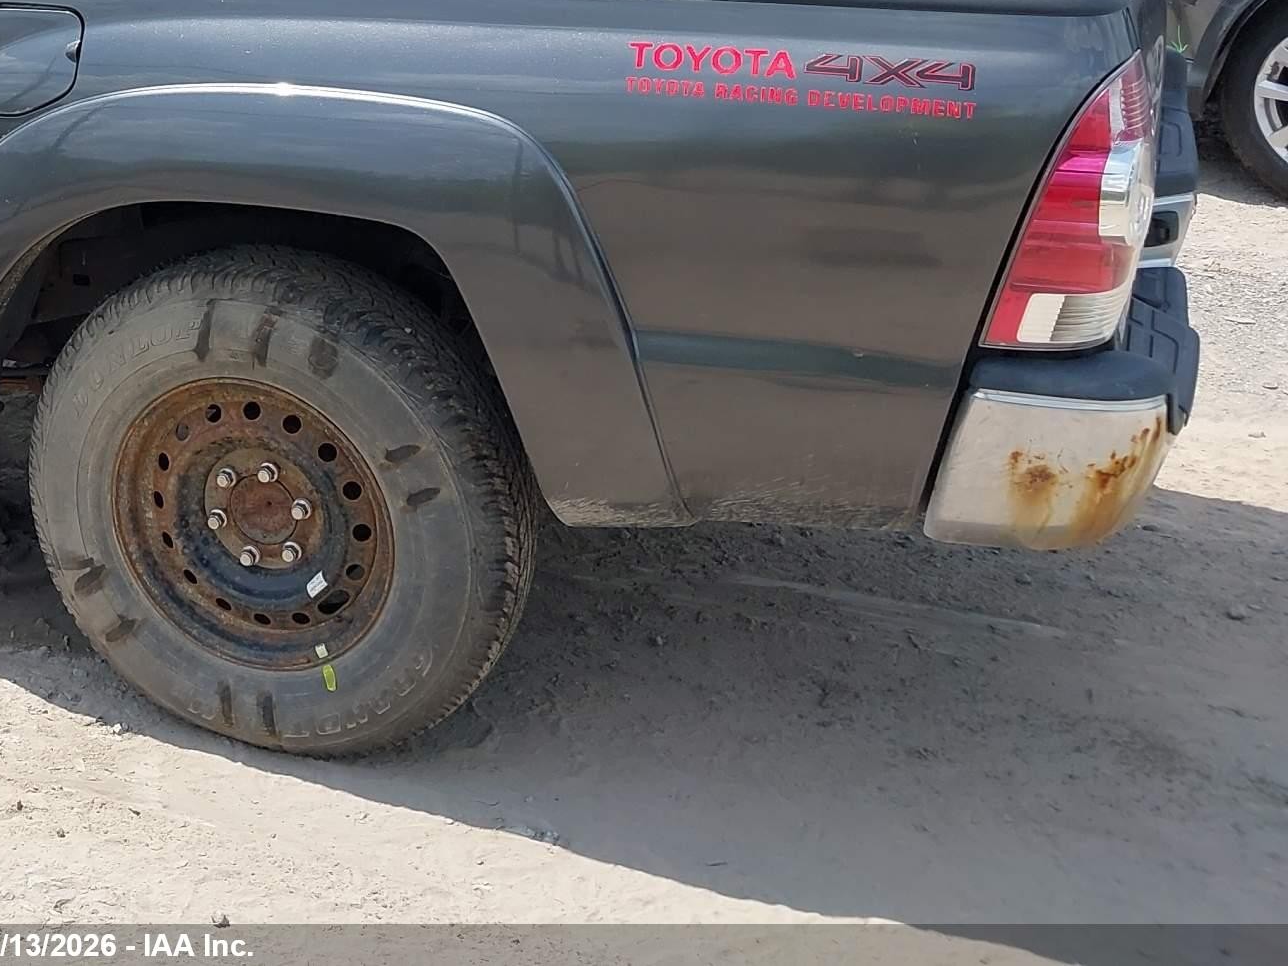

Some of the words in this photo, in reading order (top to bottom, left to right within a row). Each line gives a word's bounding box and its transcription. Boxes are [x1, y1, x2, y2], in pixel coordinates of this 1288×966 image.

[629, 41, 798, 80] TOYOTA
[624, 76, 705, 98] TOYOTA
[715, 84, 799, 106] RACING
[807, 90, 978, 119] DEVELOPMENT
